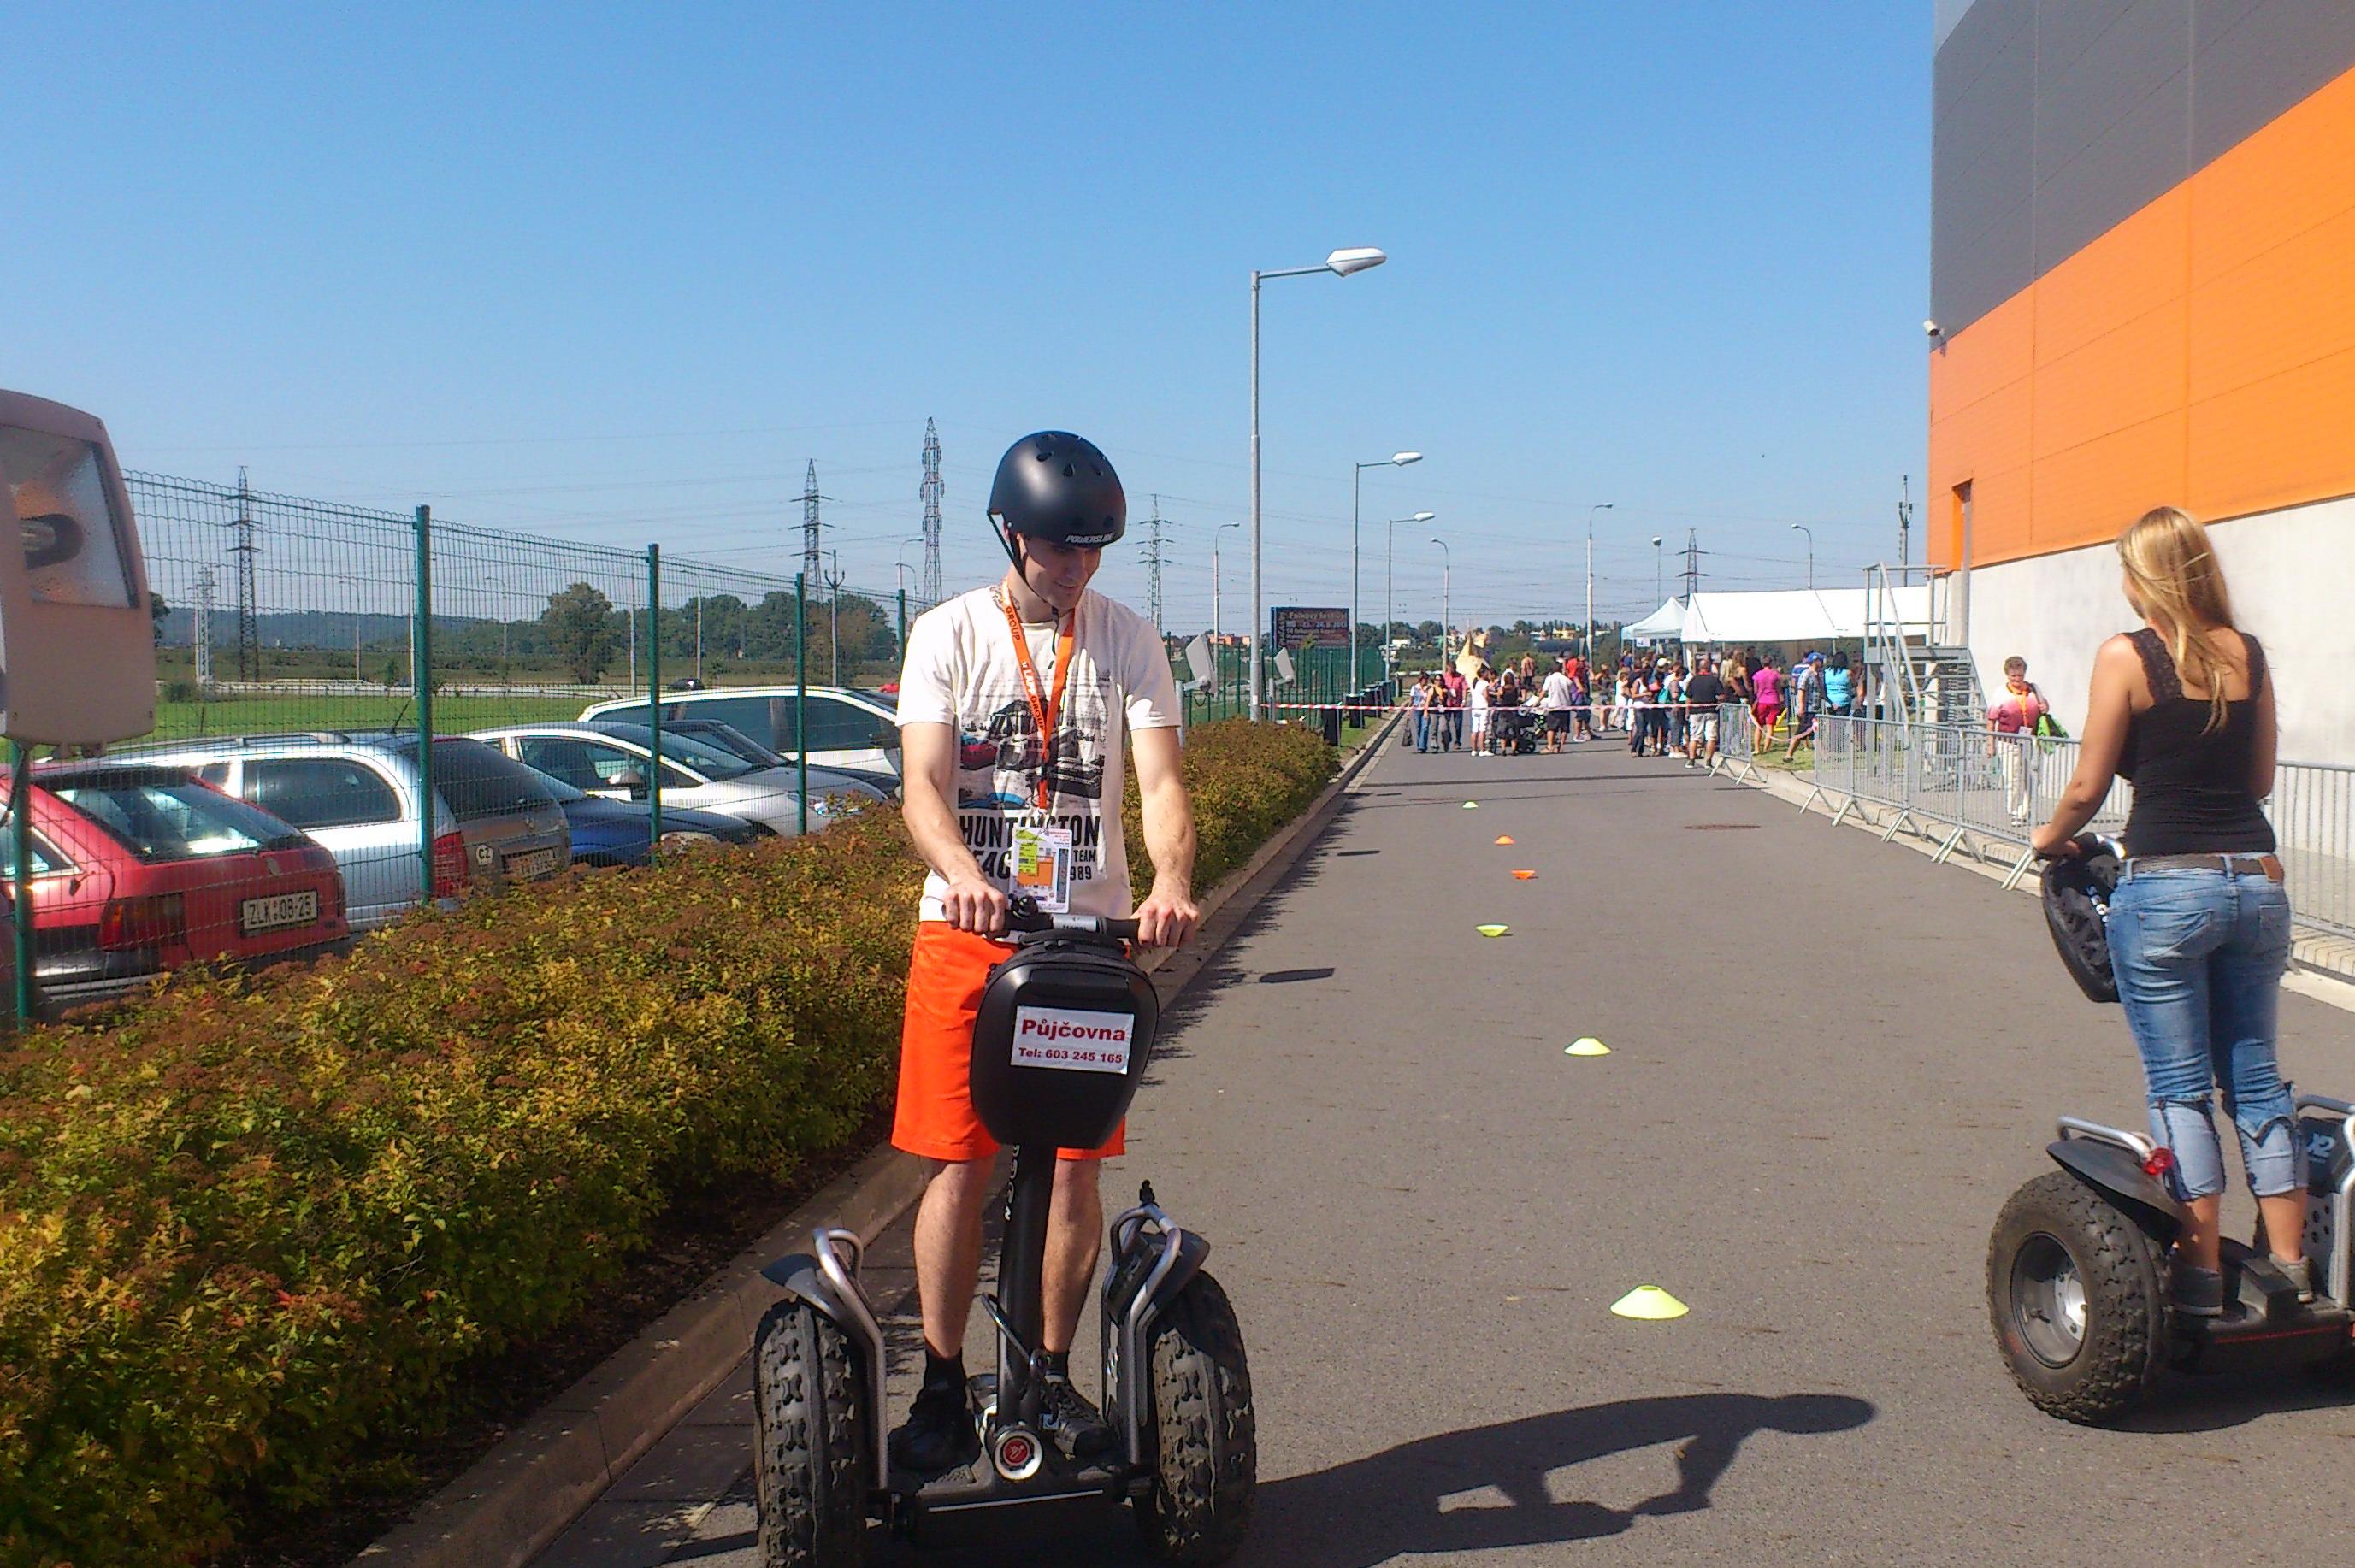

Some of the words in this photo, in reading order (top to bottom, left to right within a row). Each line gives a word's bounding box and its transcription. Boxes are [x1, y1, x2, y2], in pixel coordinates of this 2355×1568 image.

[1006, 605, 1021, 640] GROUP
[478, 847, 491, 859] CZ
[1073, 849, 1097, 862] TEAM
[1021, 1018, 1126, 1041] Půjčovna
[1018, 1047, 1042, 1058] Tel:
[1045, 1049, 1069, 1060] 603
[1072, 1051, 1095, 1061] 245
[1100, 1053, 1123, 1064] 165
